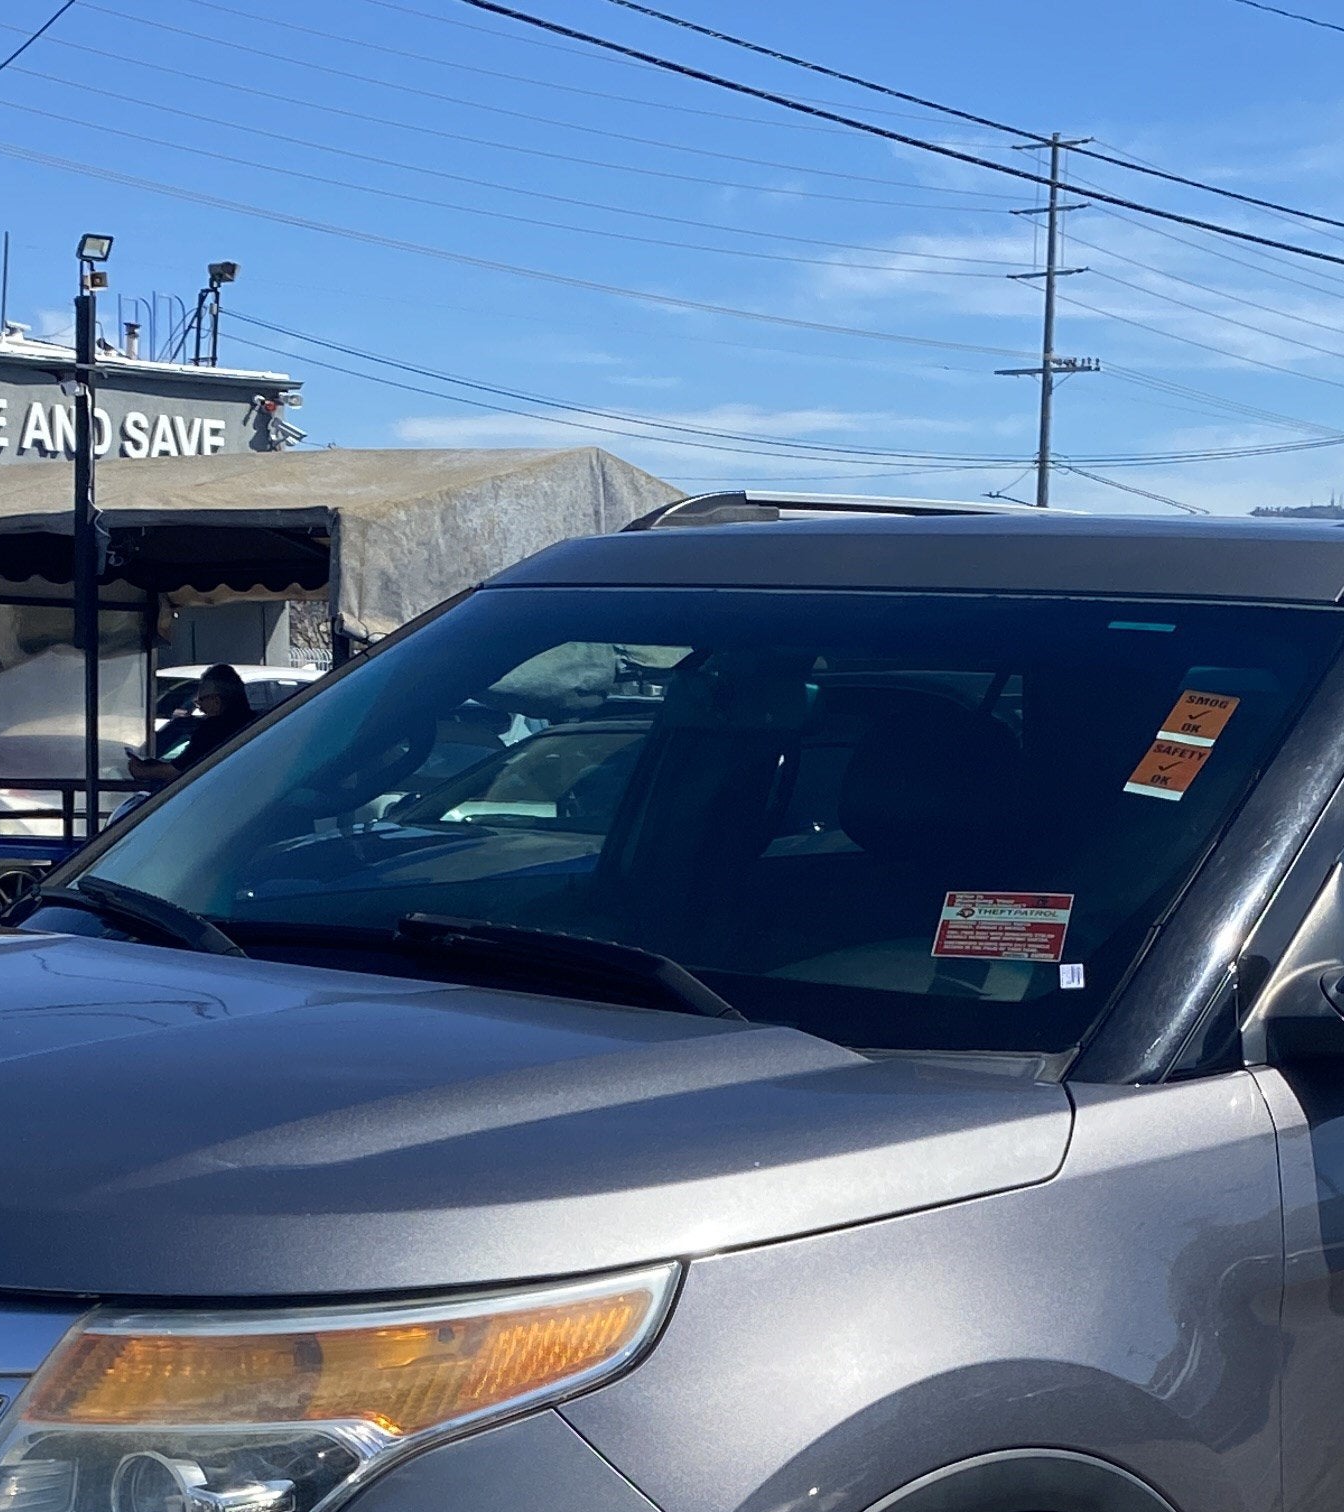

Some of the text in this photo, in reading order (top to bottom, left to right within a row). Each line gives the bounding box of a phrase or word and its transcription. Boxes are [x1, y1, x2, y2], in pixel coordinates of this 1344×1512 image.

[123, 411, 226, 459] SAVE
[1185, 695, 1229, 709] SMOG
[1181, 722, 1202, 733] OK
[1153, 743, 1207, 761] SAFETY
[1150, 774, 1173, 785] OK
